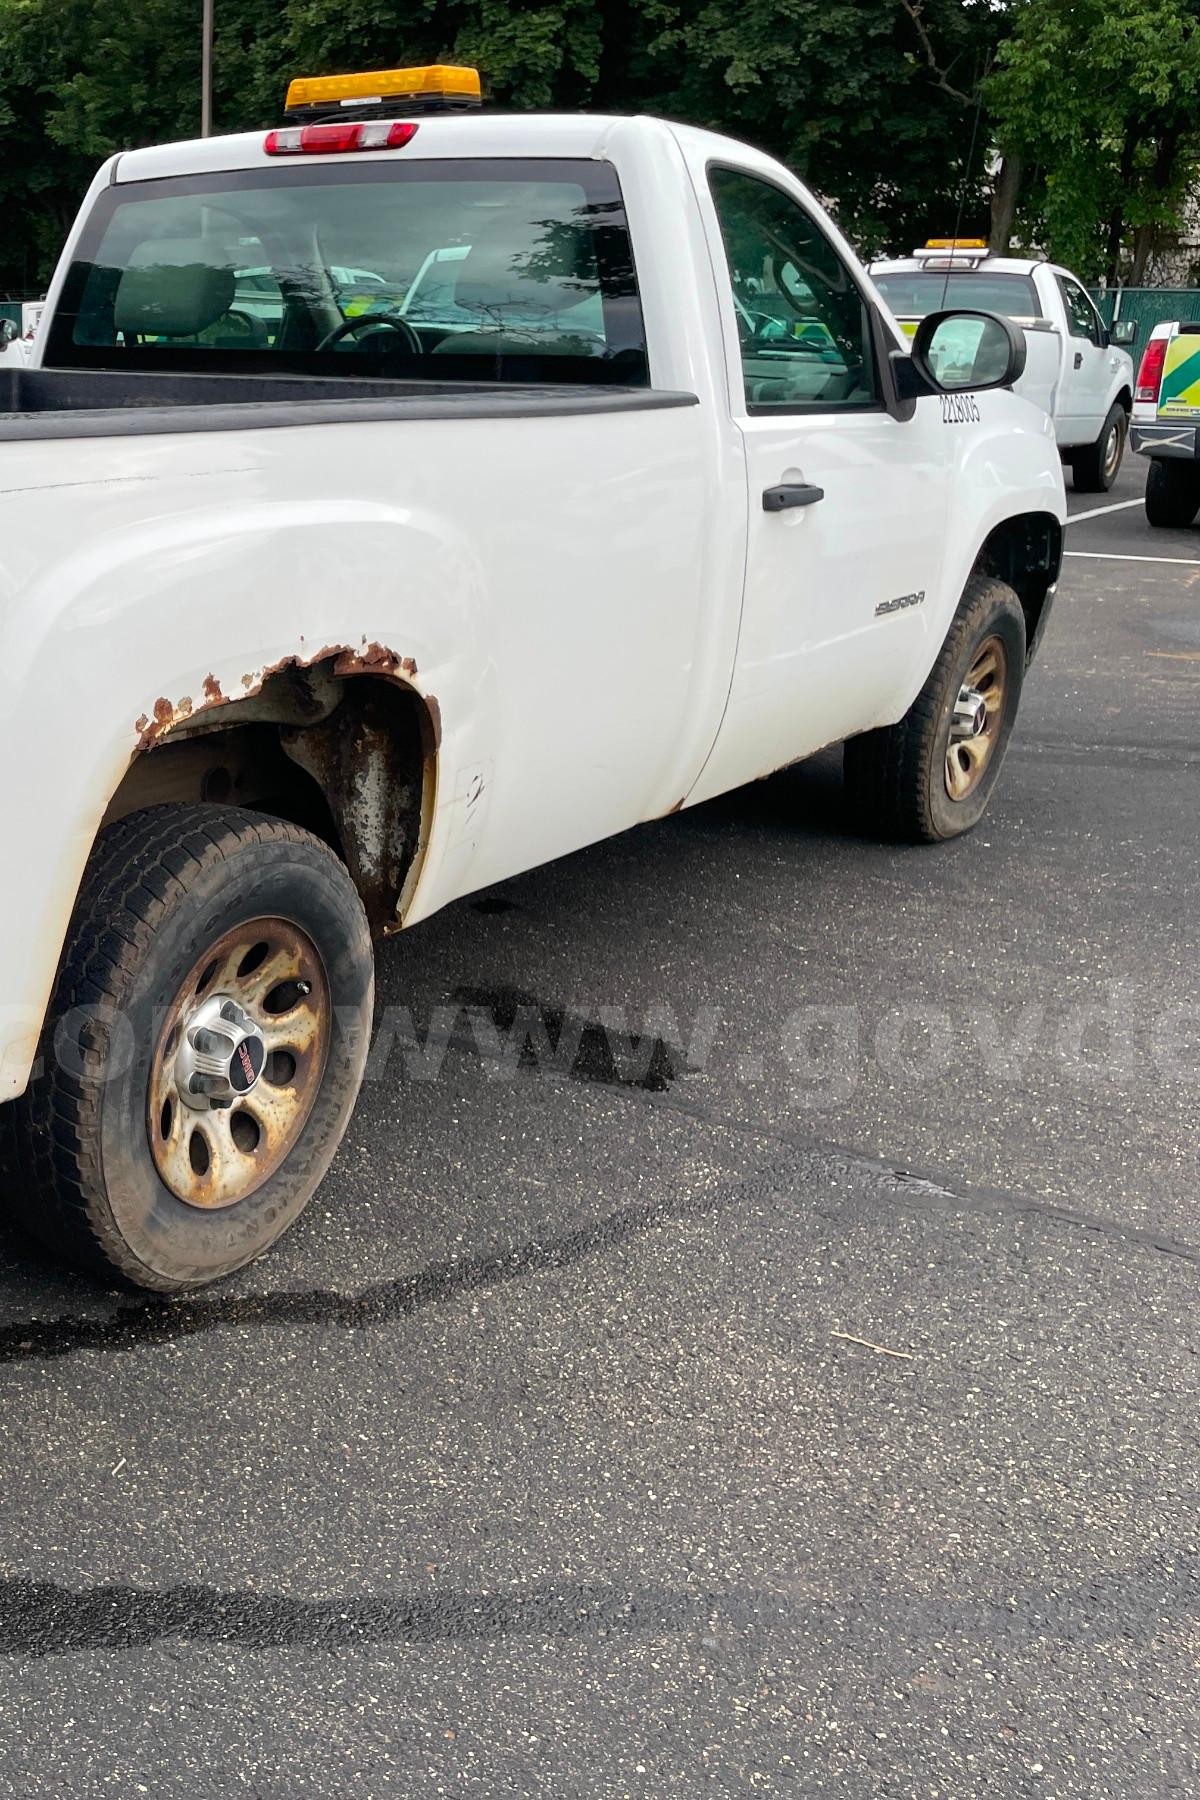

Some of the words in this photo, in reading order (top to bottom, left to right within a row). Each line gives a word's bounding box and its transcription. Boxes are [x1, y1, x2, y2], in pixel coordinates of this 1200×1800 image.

[939, 394, 980, 424] 2218005
[873, 590, 926, 617] SIERRA
[237, 1042, 255, 1085] GMC
